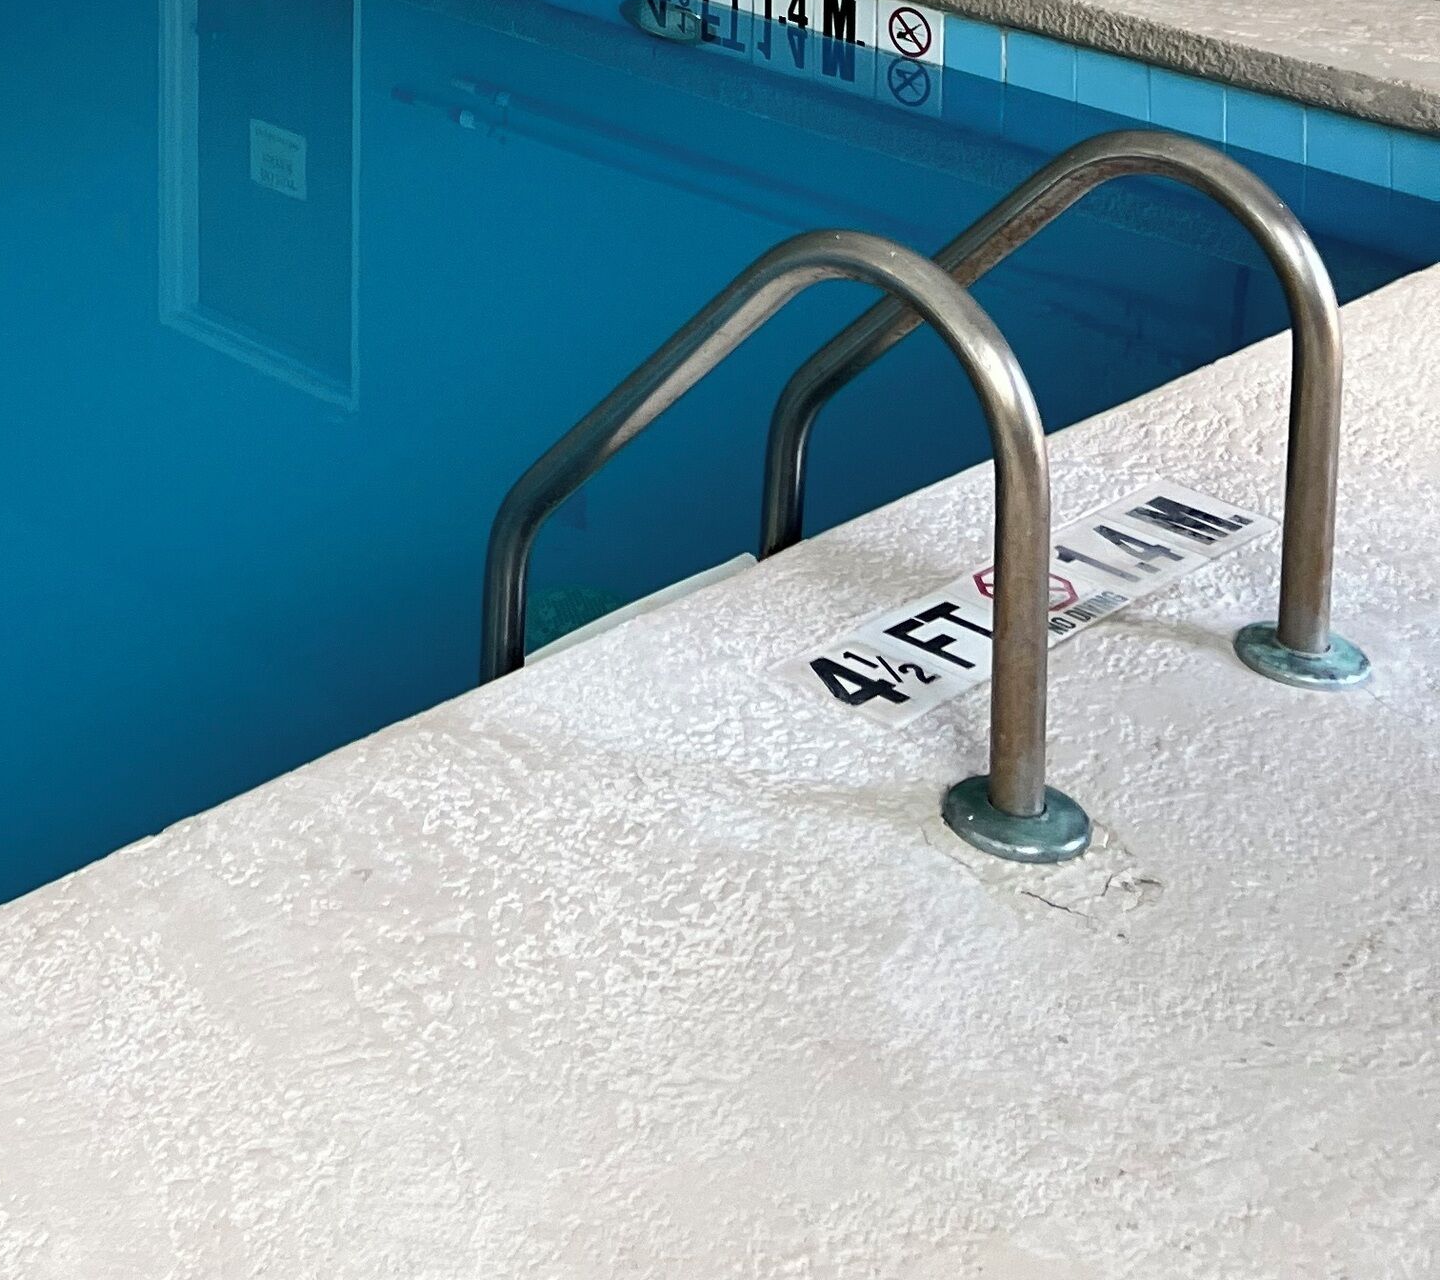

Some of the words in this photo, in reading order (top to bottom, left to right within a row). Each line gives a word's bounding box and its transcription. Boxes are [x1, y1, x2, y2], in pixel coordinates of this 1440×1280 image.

[883, 601, 994, 669] FT
[1049, 617, 1076, 635] NO
[1066, 590, 1129, 623] DIVING
